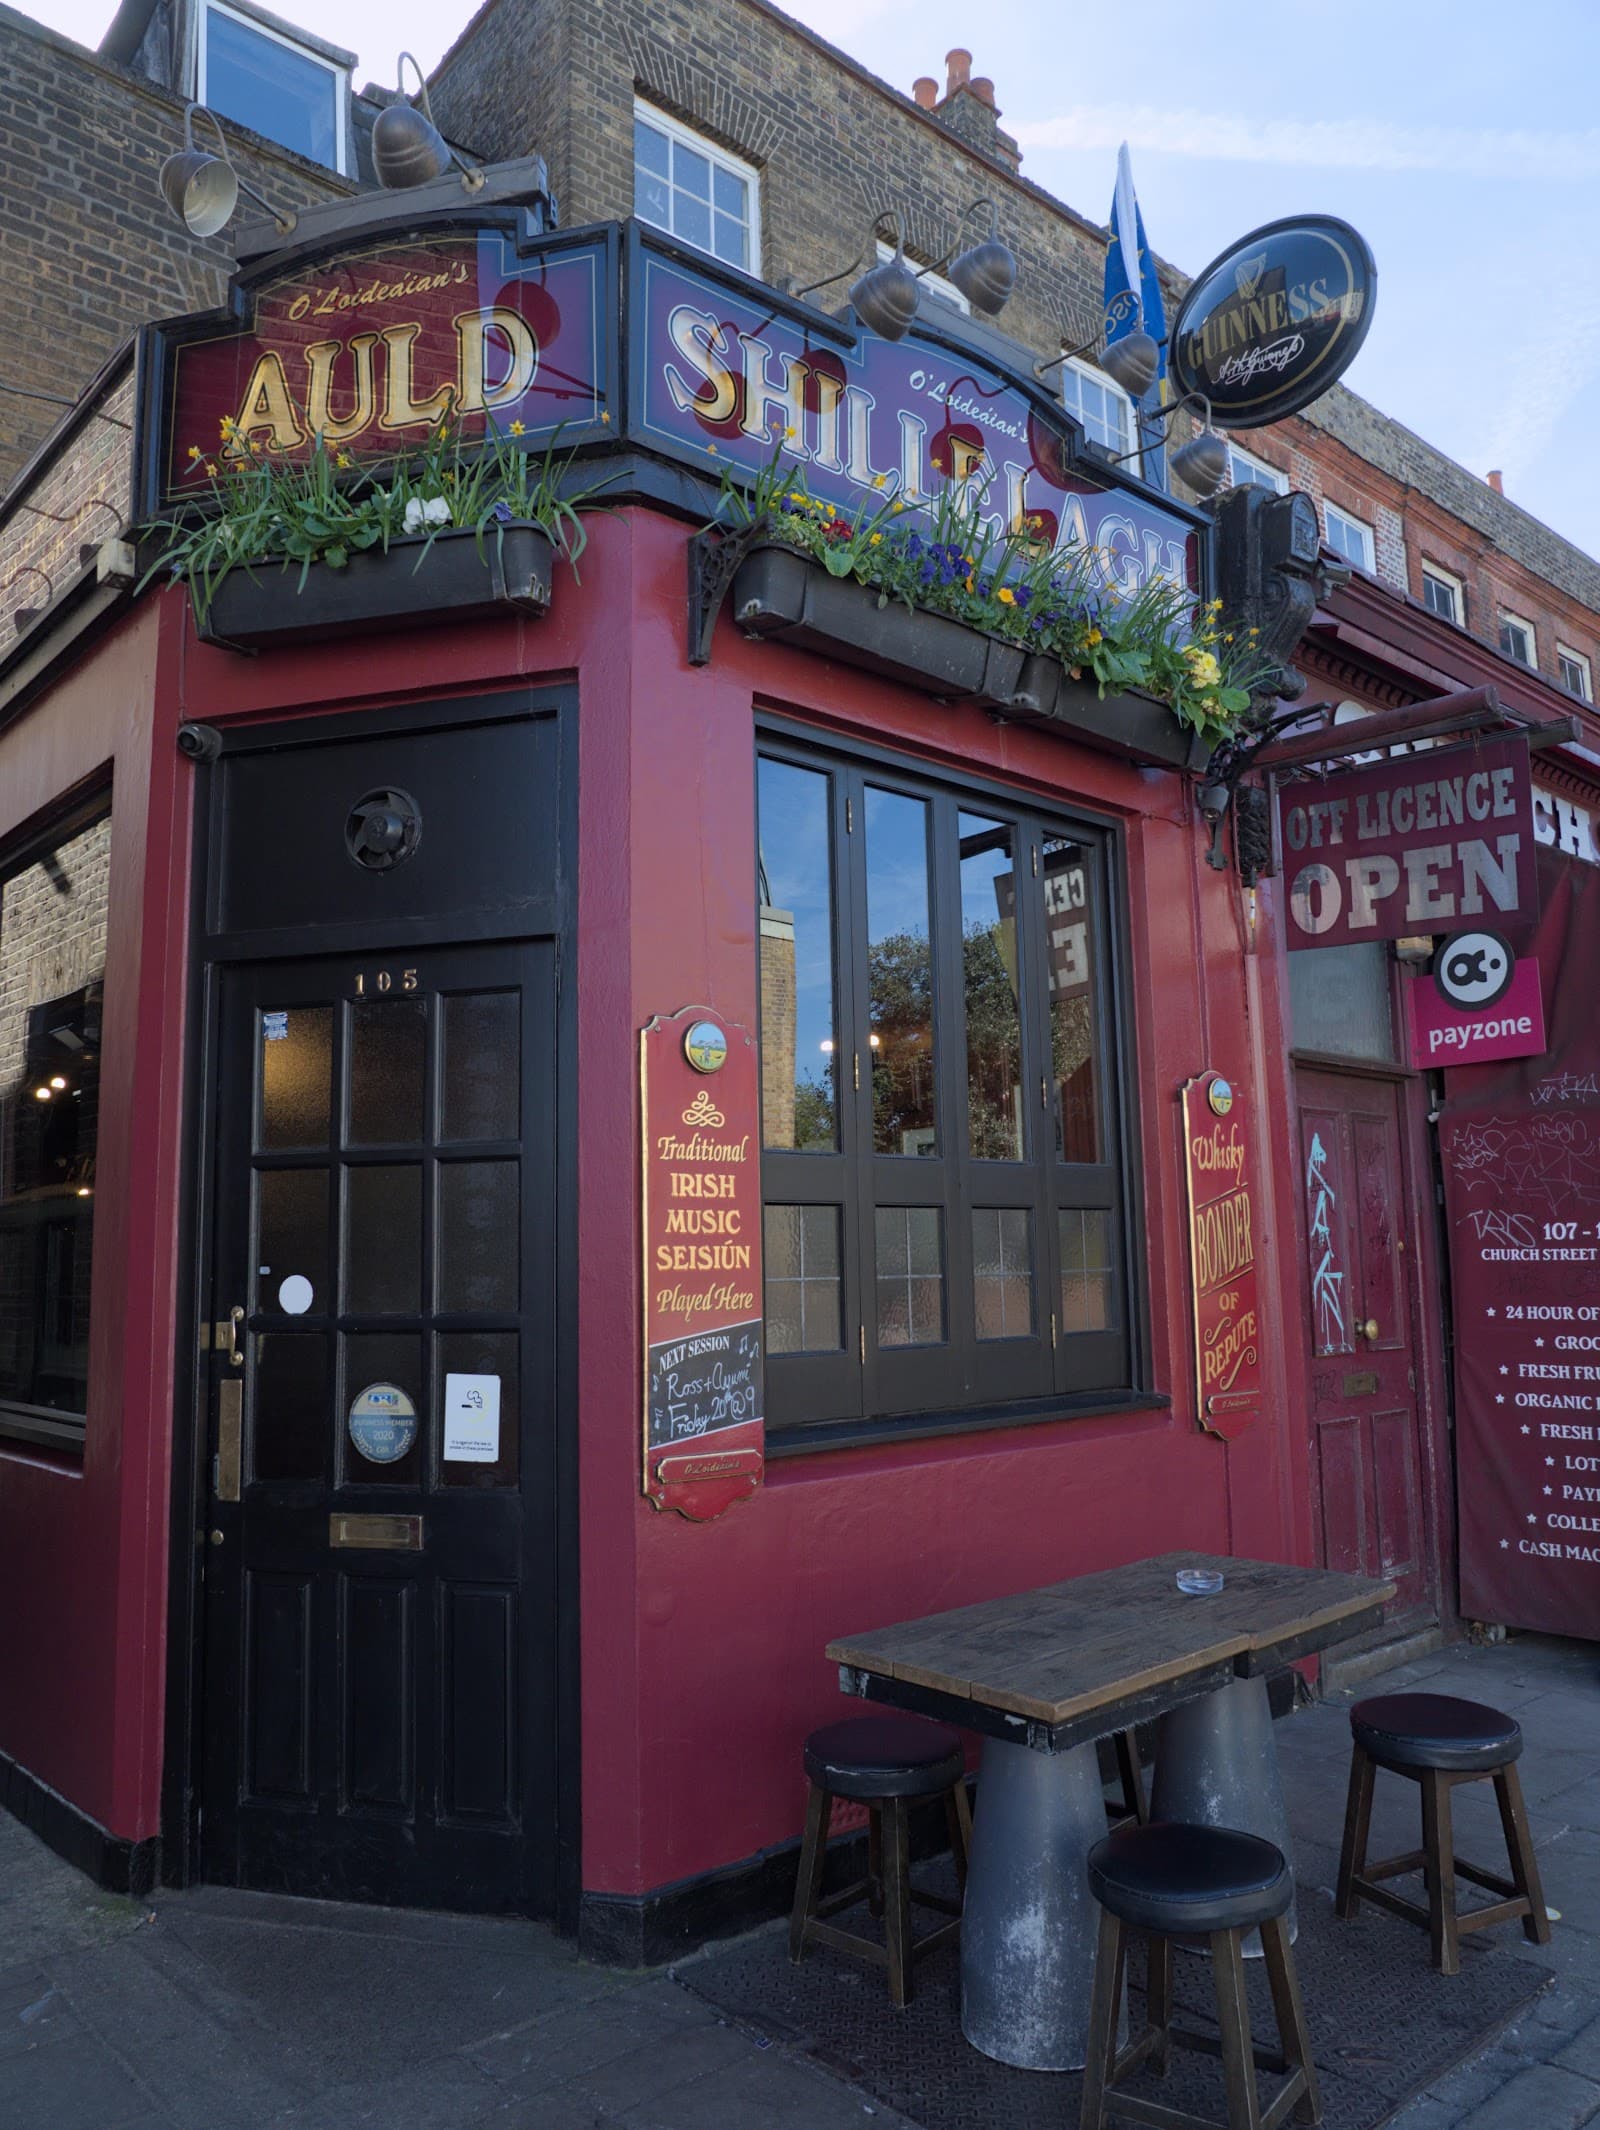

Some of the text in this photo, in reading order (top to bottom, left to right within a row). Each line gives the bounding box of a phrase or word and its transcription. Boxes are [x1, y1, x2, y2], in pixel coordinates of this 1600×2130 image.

[1186, 276, 1331, 371] GUINNESS
[221, 304, 541, 462] AULD
[662, 303, 1192, 625] SHILLELAGH
[1285, 766, 1517, 852] OFF LICENCE
[1289, 832, 1521, 935] OPEN
[354, 968, 418, 994] 105
[1428, 1013, 1532, 1052] payzone
[657, 1132, 750, 1163] Traditional
[1192, 1121, 1245, 1187] Whisky
[670, 1172, 736, 1199] IRISH
[664, 1208, 741, 1235] MUSIC
[1542, 1222, 1578, 1241] 107
[1195, 1190, 1255, 1290] BONDER
[655, 1240, 751, 1272] SEISIÚN
[1480, 1248, 1598, 1261] CHURCH STREET
[656, 1281, 753, 1322] Played Here
[1218, 1290, 1240, 1313] OF
[1505, 1305, 1524, 1320] 24
[1526, 1305, 1575, 1321] HOUR
[658, 1335, 731, 1375] NEXT SESSION
[1203, 1310, 1257, 1386] REPUTE
[1554, 1335, 1600, 1351] GROC
[1518, 1363, 1571, 1380] FRESH
[1514, 1392, 1593, 1410] ORGANIC
[373, 1429, 395, 1441] 2020
[1540, 1423, 1594, 1441] FRESH
[1546, 1513, 1600, 1532] COLLE
[1518, 1538, 1600, 1563] CASH MAC
